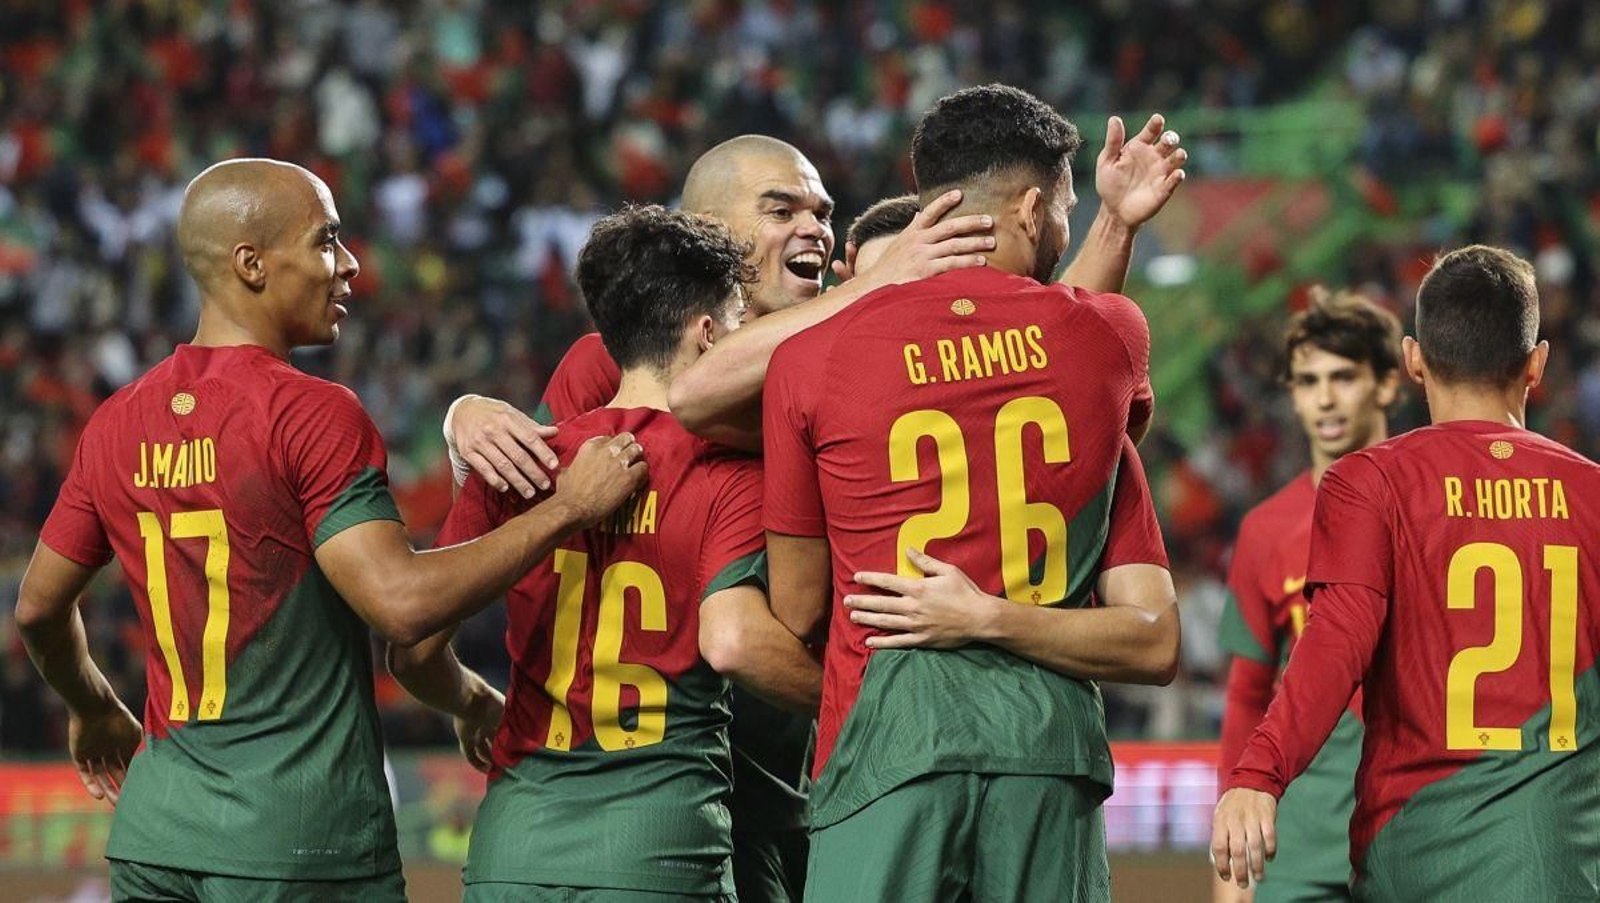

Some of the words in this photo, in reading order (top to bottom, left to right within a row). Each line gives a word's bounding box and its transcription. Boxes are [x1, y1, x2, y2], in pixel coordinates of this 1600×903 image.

[888, 396, 1071, 606] 26
[136, 509, 230, 721] 17
[545, 548, 667, 752] 16
[1446, 542, 1578, 752] 21
